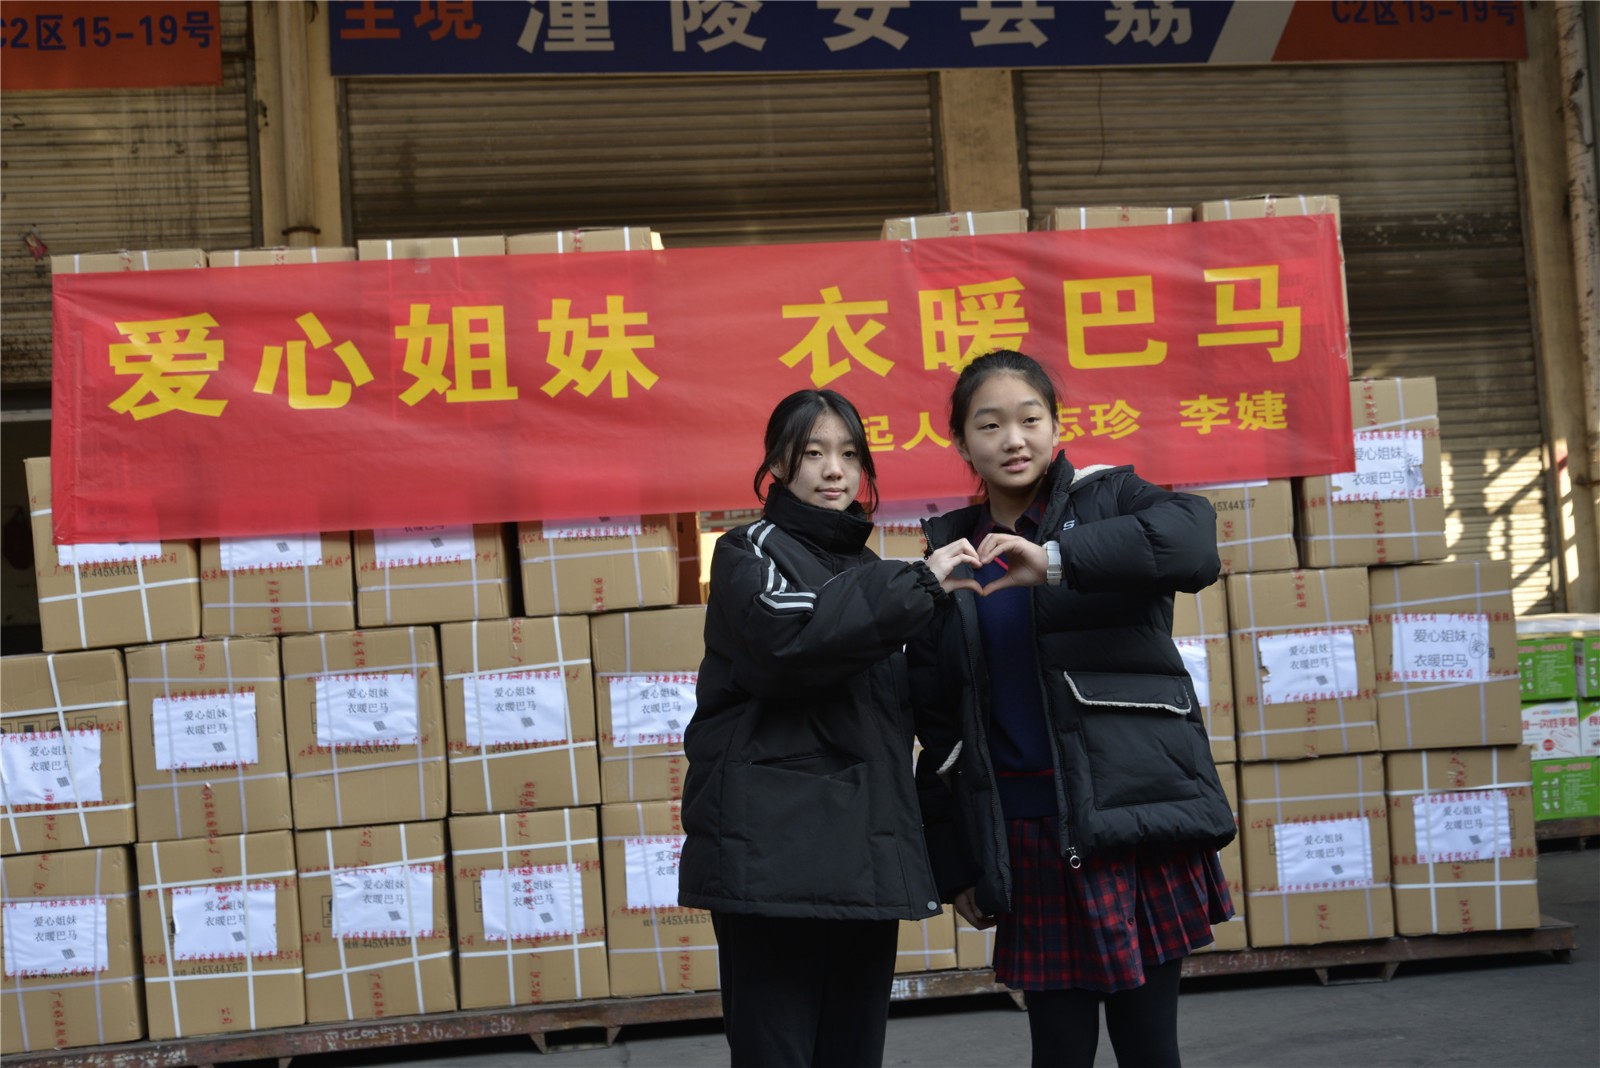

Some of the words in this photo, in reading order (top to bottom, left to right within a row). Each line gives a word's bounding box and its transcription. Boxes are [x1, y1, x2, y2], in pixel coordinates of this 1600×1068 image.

[108, 295, 659, 421] 爱心姐妹
[779, 264, 1302, 389] 衣暖巴马
[1355, 447, 1404, 462] 爱心姐妹
[1352, 470, 1404, 486] 衣暖巴马
[1213, 498, 1256, 513] 5X44X7
[1414, 629, 1469, 643] 爱心姐妹
[1289, 644, 1329, 656] 爱心姐妹
[1290, 657, 1330, 670] 衣暖巴马
[1414, 653, 1469, 668] 衣暖巴马
[346, 688, 389, 699] 爱心姐妹
[494, 685, 536, 698] 爱心姐妹
[639, 687, 680, 700] 爱心姐妹
[346, 702, 389, 714] 衣暖巴马
[495, 701, 537, 713] 衣暖巴马
[641, 702, 681, 714] 衣暖巴马
[184, 708, 228, 721] 爱心姐妹
[185, 723, 228, 736] 衣暖巴马
[1443, 805, 1482, 817] 爱心姐妹
[1444, 820, 1484, 831] 衣暖巴马
[1304, 833, 1344, 846] 爱心姐妹
[1304, 848, 1345, 860] 衣暖巴马
[362, 879, 405, 890] 爱心姐妹
[362, 894, 405, 905] 衣暖巴马
[34, 915, 77, 928] 爱心姐妹
[35, 930, 78, 942] 衣暖巴马
